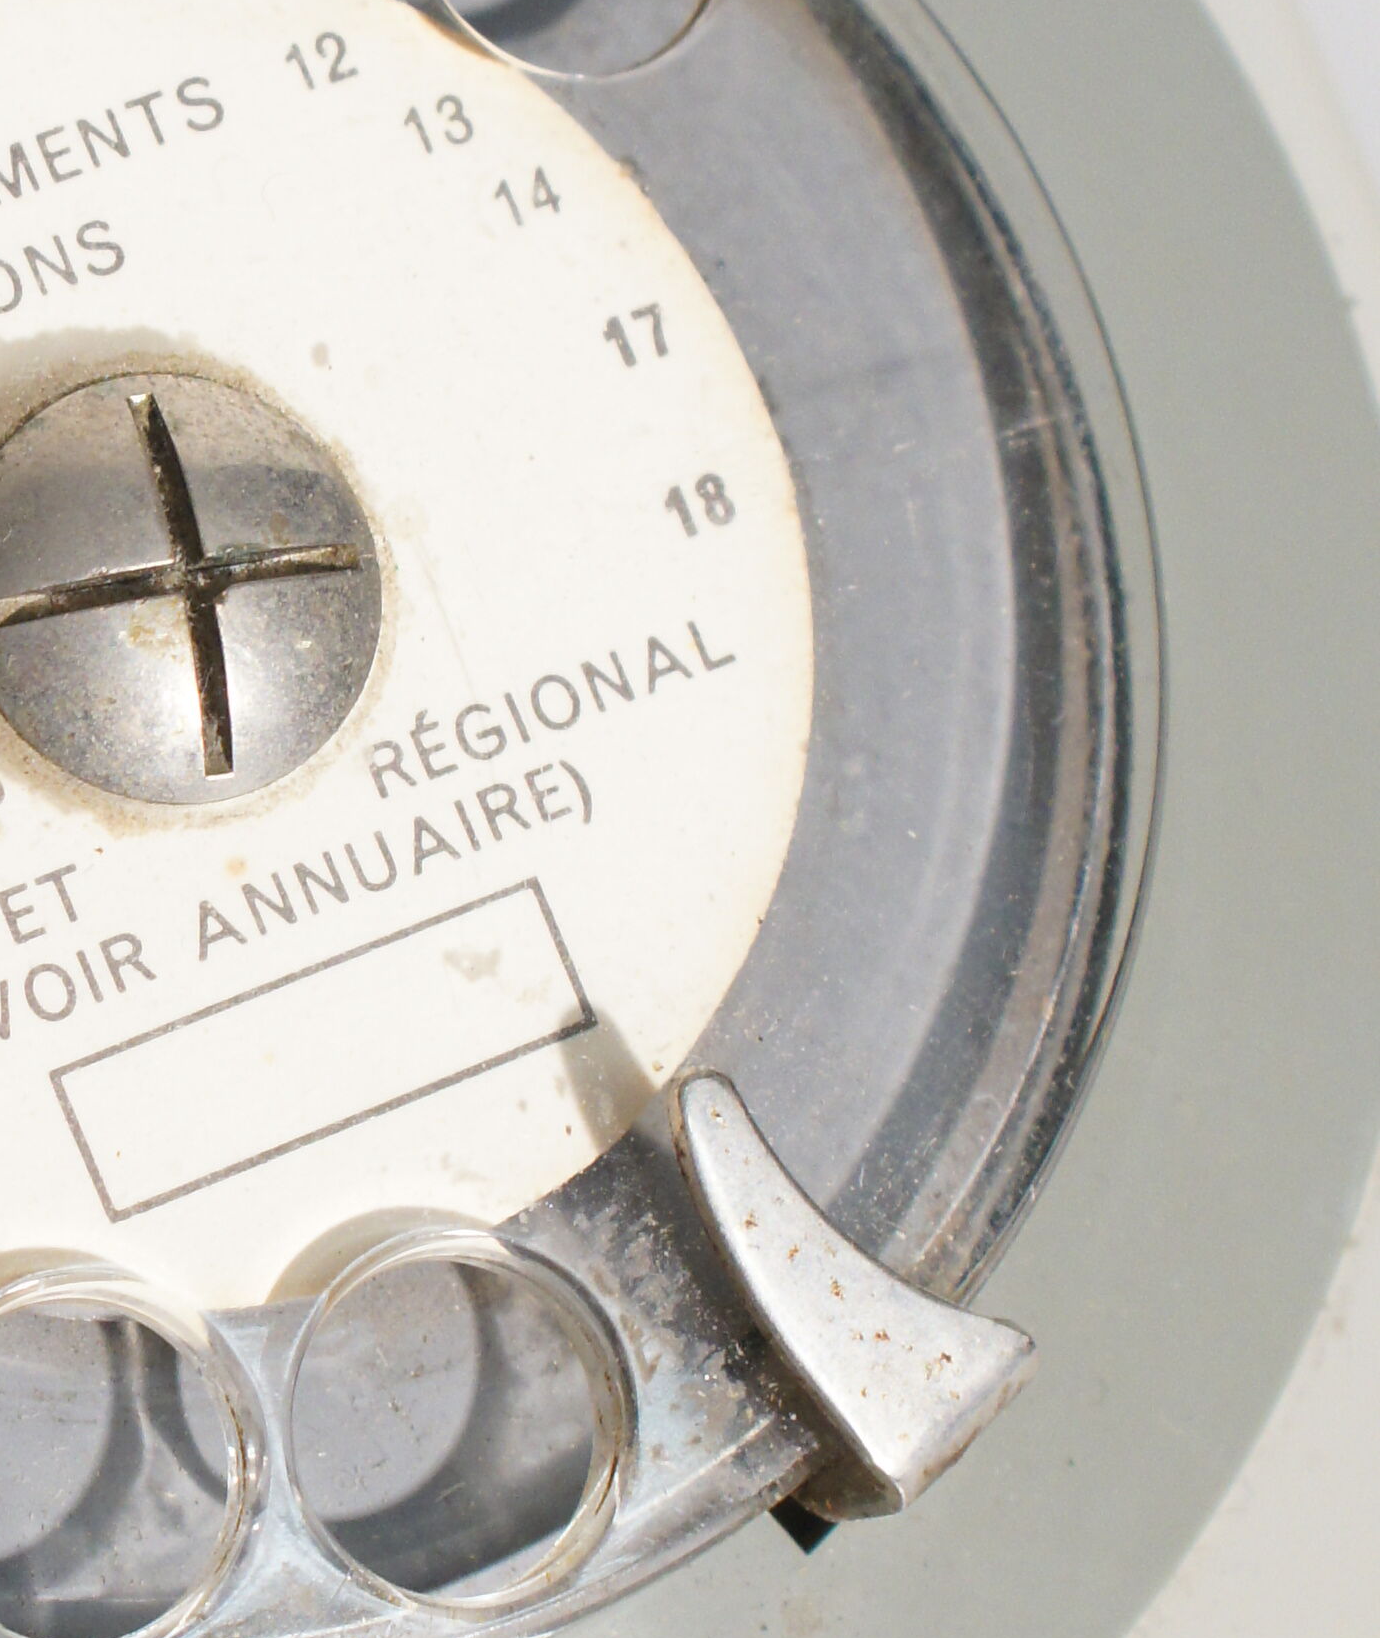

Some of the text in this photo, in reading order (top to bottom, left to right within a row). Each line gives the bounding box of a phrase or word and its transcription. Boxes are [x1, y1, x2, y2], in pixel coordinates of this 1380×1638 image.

[285, 31, 359, 91] 12
[404, 94, 474, 154] 13
[493, 167, 561, 226] 14
[602, 303, 670, 368] 17
[663, 473, 736, 537] 18
[368, 620, 737, 799] RÉGIONAL
[196, 759, 595, 962] ANNUAIRE)
